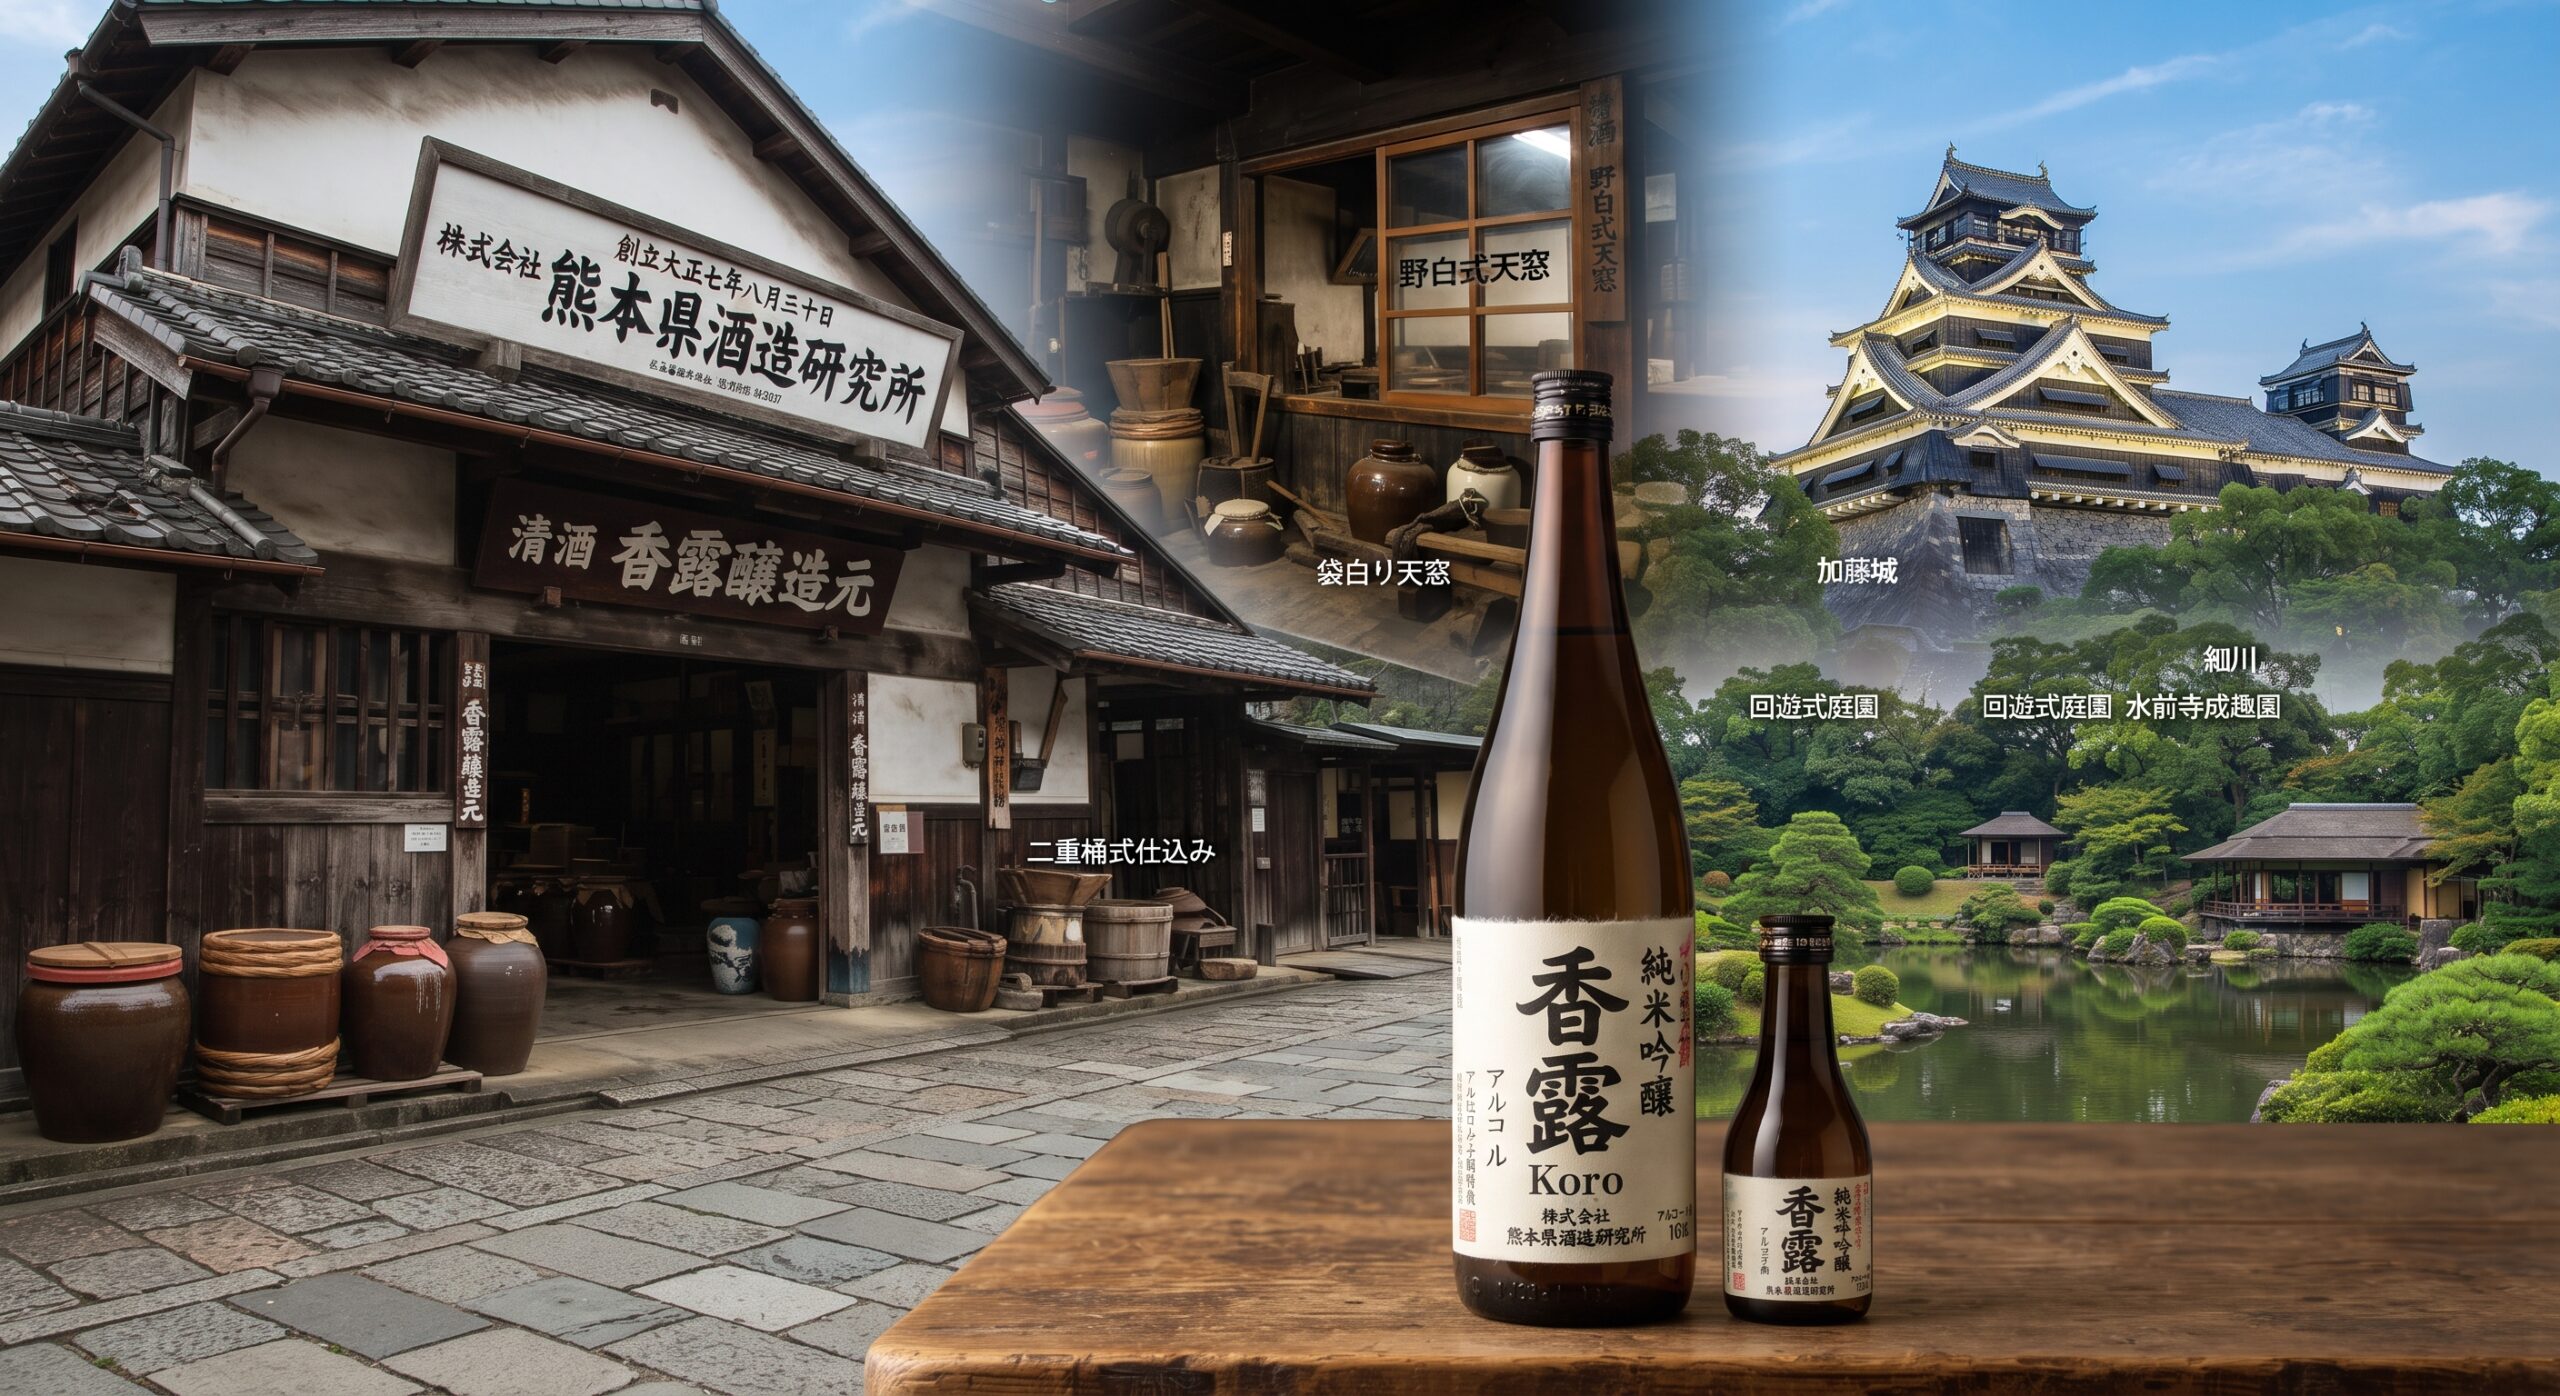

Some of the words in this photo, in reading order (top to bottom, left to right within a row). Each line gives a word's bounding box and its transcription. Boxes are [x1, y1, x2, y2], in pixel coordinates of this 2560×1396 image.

[1399, 248, 1551, 290] 野白式天窓
[1588, 165, 1619, 294] 野白式天窓
[436, 222, 543, 281] 株式会社
[541, 249, 926, 425] 熊本県酒造研究所
[614, 233, 835, 329] 創立大正七年八月三十日
[508, 514, 598, 570] 清酒
[611, 520, 876, 617] 香露醸造元
[1516, 945, 1631, 1157] 香露
[1639, 945, 1677, 1118] 純米吟醸
[1486, 1069, 1507, 1168] アルコル
[1528, 1164, 1625, 1196] Koro
[1541, 1207, 1611, 1227] 株式会社
[1506, 1226, 1647, 1248] 熊本県酒造研究所
[1775, 1185, 1826, 1274] 香露
